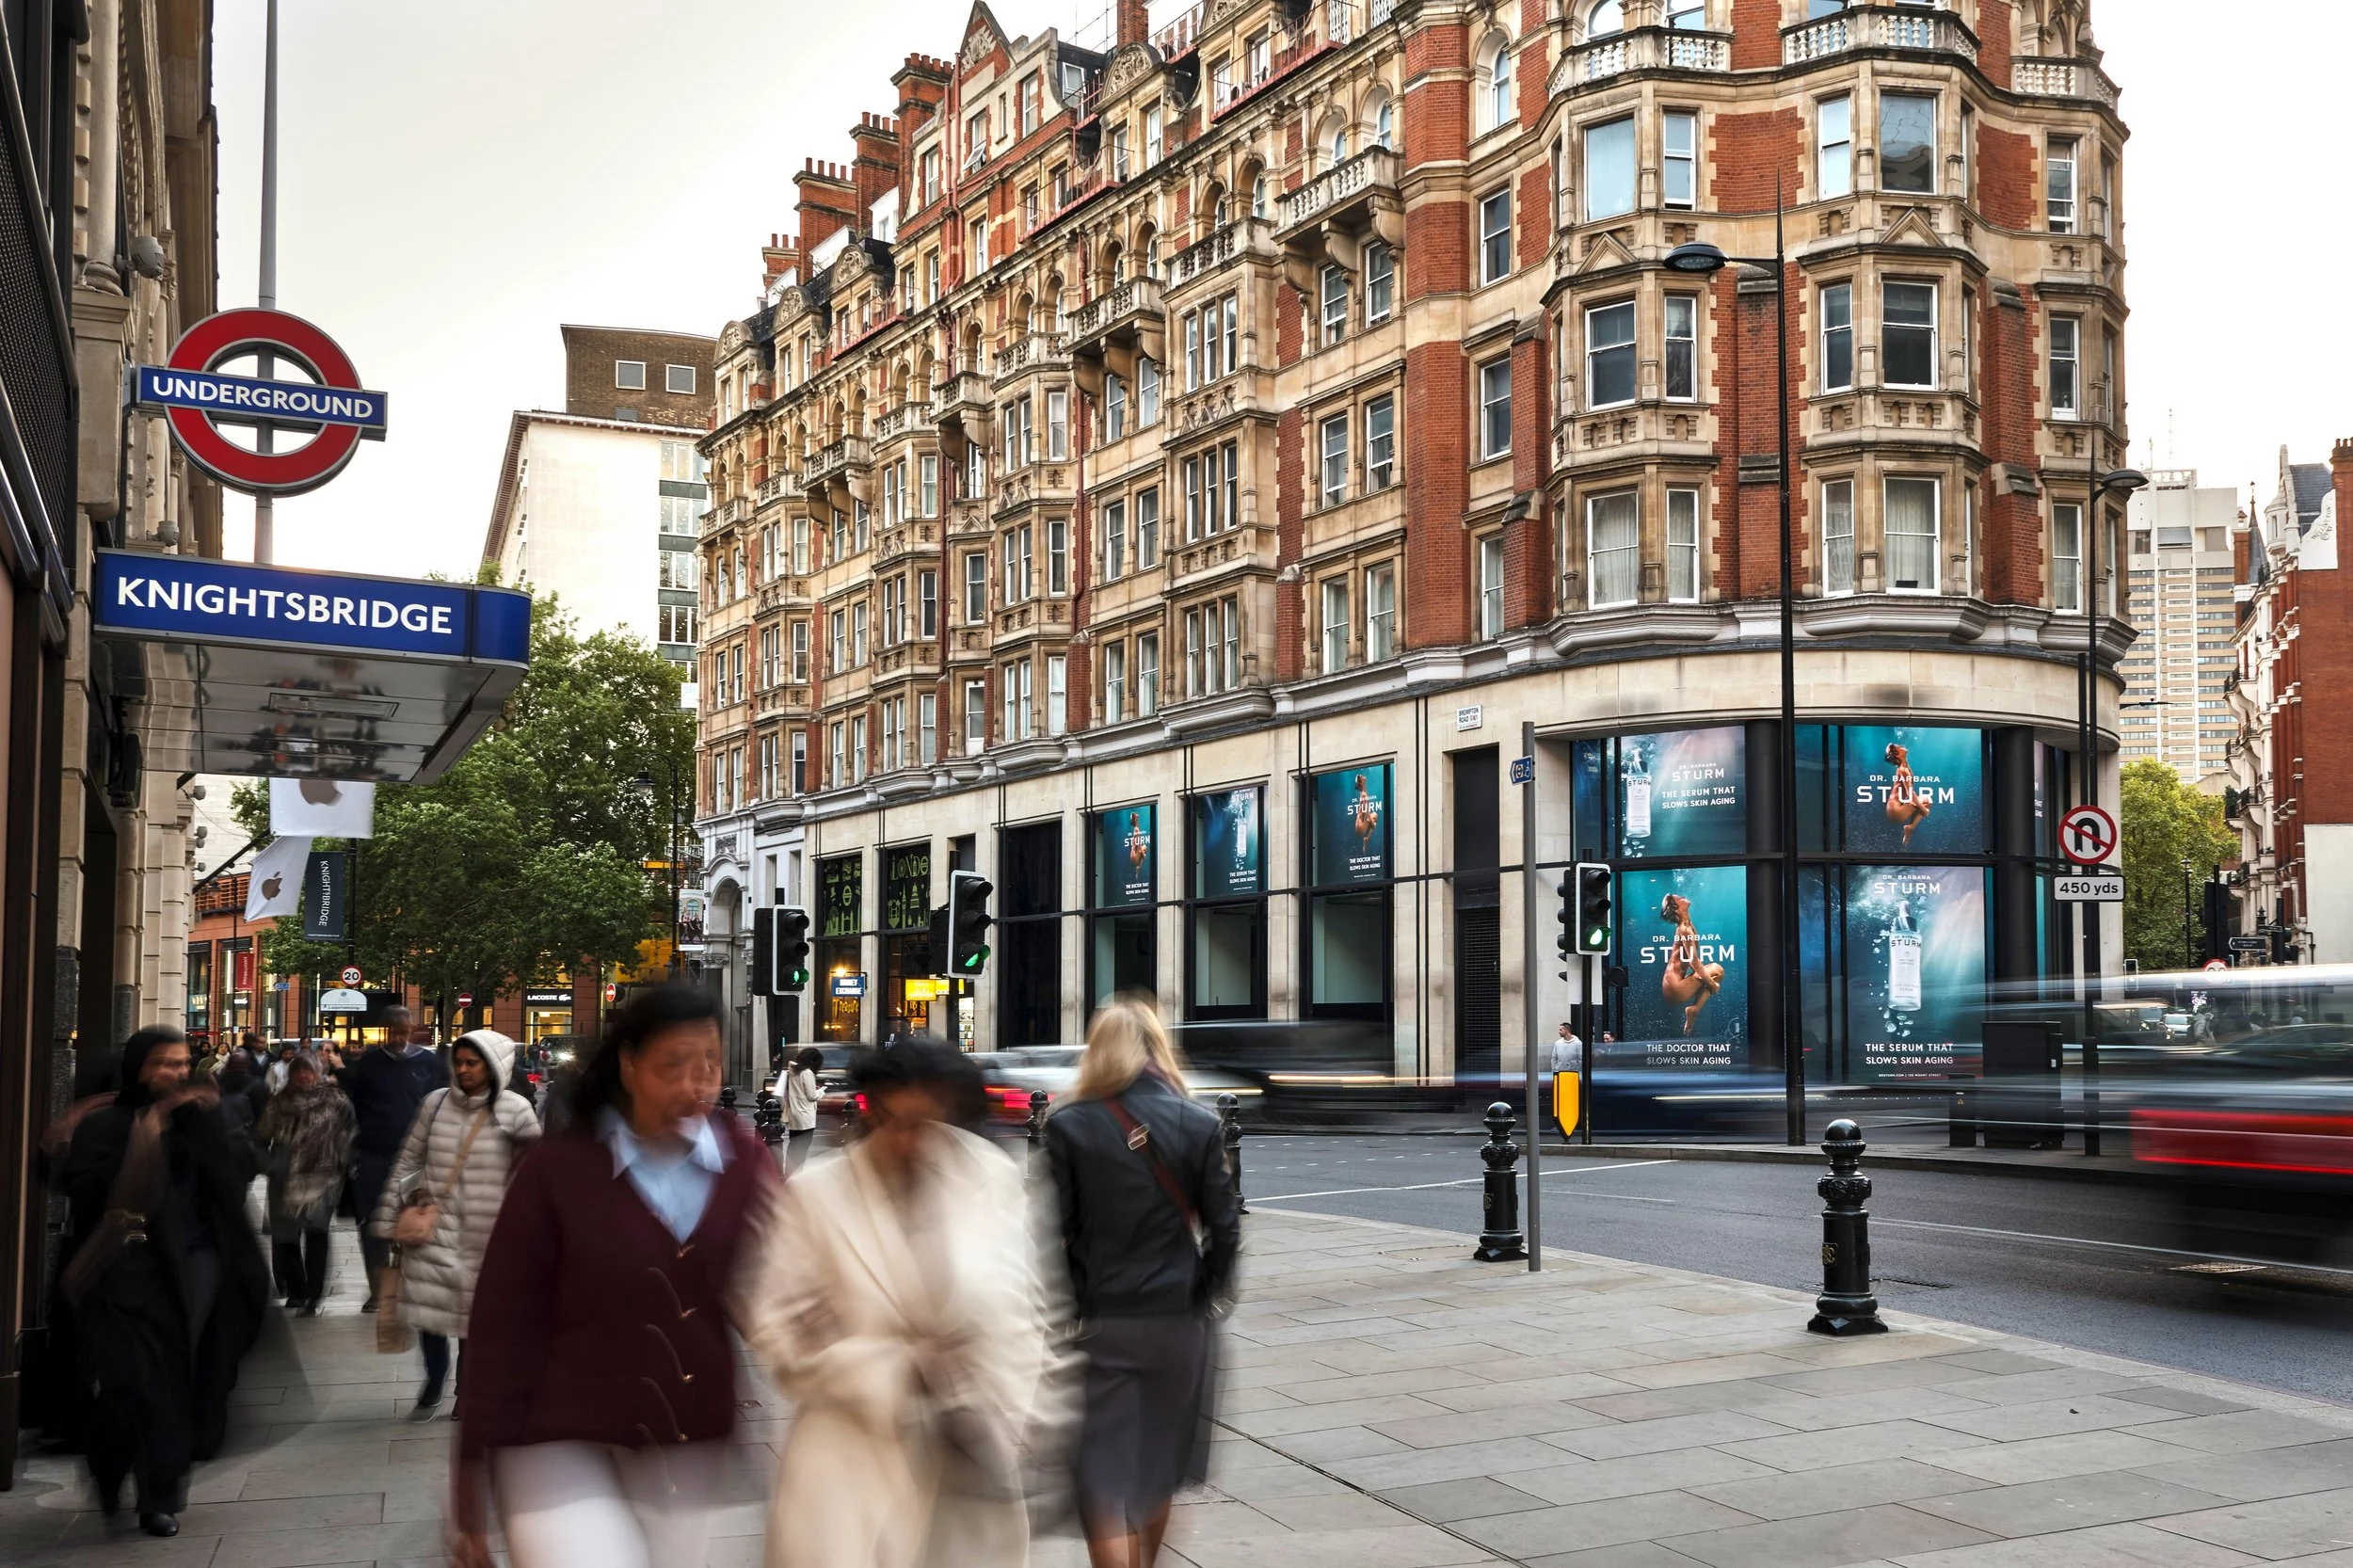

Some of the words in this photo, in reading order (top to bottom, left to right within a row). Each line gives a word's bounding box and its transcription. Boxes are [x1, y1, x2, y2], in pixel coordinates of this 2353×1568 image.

[152, 376, 373, 419] UNDERGROUND
[118, 576, 452, 634] KNIGHTSBRIDGE
[1459, 708, 1479, 716] BROMPTON
[1459, 715, 1469, 724] ROAD
[1672, 768, 1724, 782] STURM
[1892, 775, 1941, 783] BARBARA
[1231, 792, 1255, 803] STURM
[1662, 790, 1677, 798] THE
[1681, 788, 1709, 797] SERUM
[1713, 786, 1736, 795] THAT
[1856, 785, 1955, 804] STURM
[1347, 801, 1383, 815] STURM
[1662, 801, 1689, 809] SLOWS
[1690, 798, 1708, 808] SKIN
[1710, 796, 1736, 806] AGING
[1124, 835, 1151, 847] STURM
[318, 860, 331, 927] KNIGHTSBRIDGE
[1874, 882, 1941, 895] STURM
[2059, 882, 2090, 893] 450
[2094, 882, 2118, 896] yds
[1891, 938, 1922, 949] STURM
[1640, 944, 1735, 964] STURM
[344, 971, 360, 981] 20
[1646, 1044, 1663, 1052] THE
[1666, 1044, 1705, 1052] DOCTOR
[1706, 1044, 1731, 1052] THAT
[1865, 1043, 1885, 1052] THE
[1888, 1043, 1924, 1052] SERUM
[1927, 1043, 1954, 1052] THAT
[1646, 1056, 1676, 1065] SLOWS
[1679, 1056, 1700, 1065] SKIN
[1702, 1056, 1731, 1065] AGING
[1865, 1056, 1897, 1064] SLOWS
[1900, 1056, 1922, 1064] SKIN
[1924, 1056, 1954, 1064] AGING
